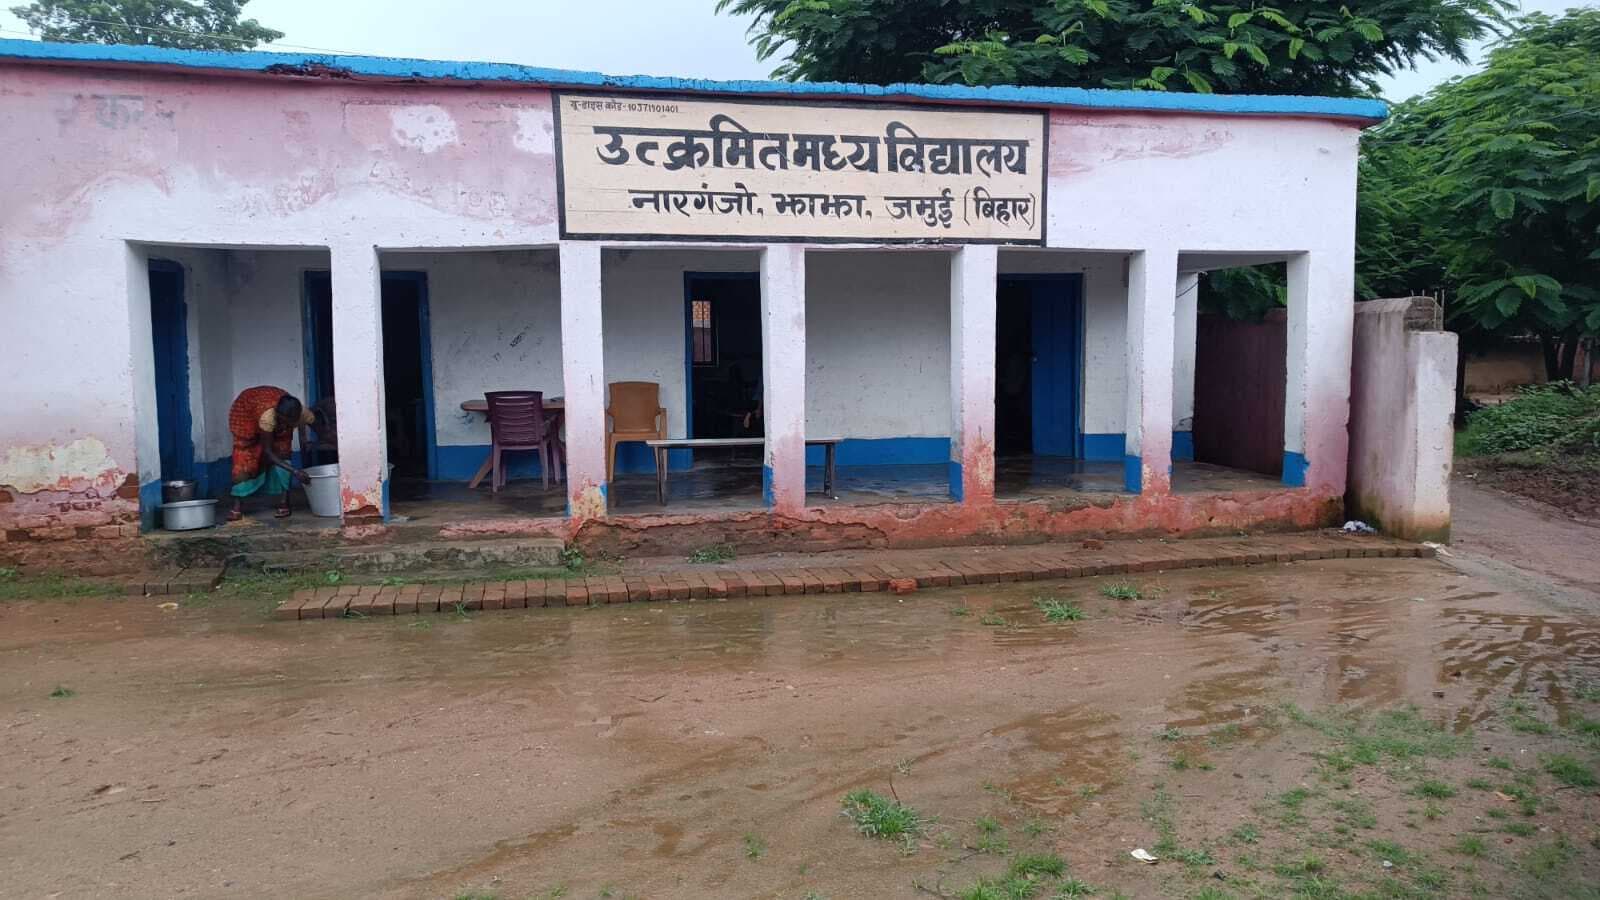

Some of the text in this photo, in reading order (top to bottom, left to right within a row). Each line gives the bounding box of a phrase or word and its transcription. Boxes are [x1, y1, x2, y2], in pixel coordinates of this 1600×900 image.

[592, 114, 1030, 178] उत्क्रमित मध्य विद्यालय
[884, 188, 955, 229] जमुई
[963, 186, 1036, 231] (बिहार)
